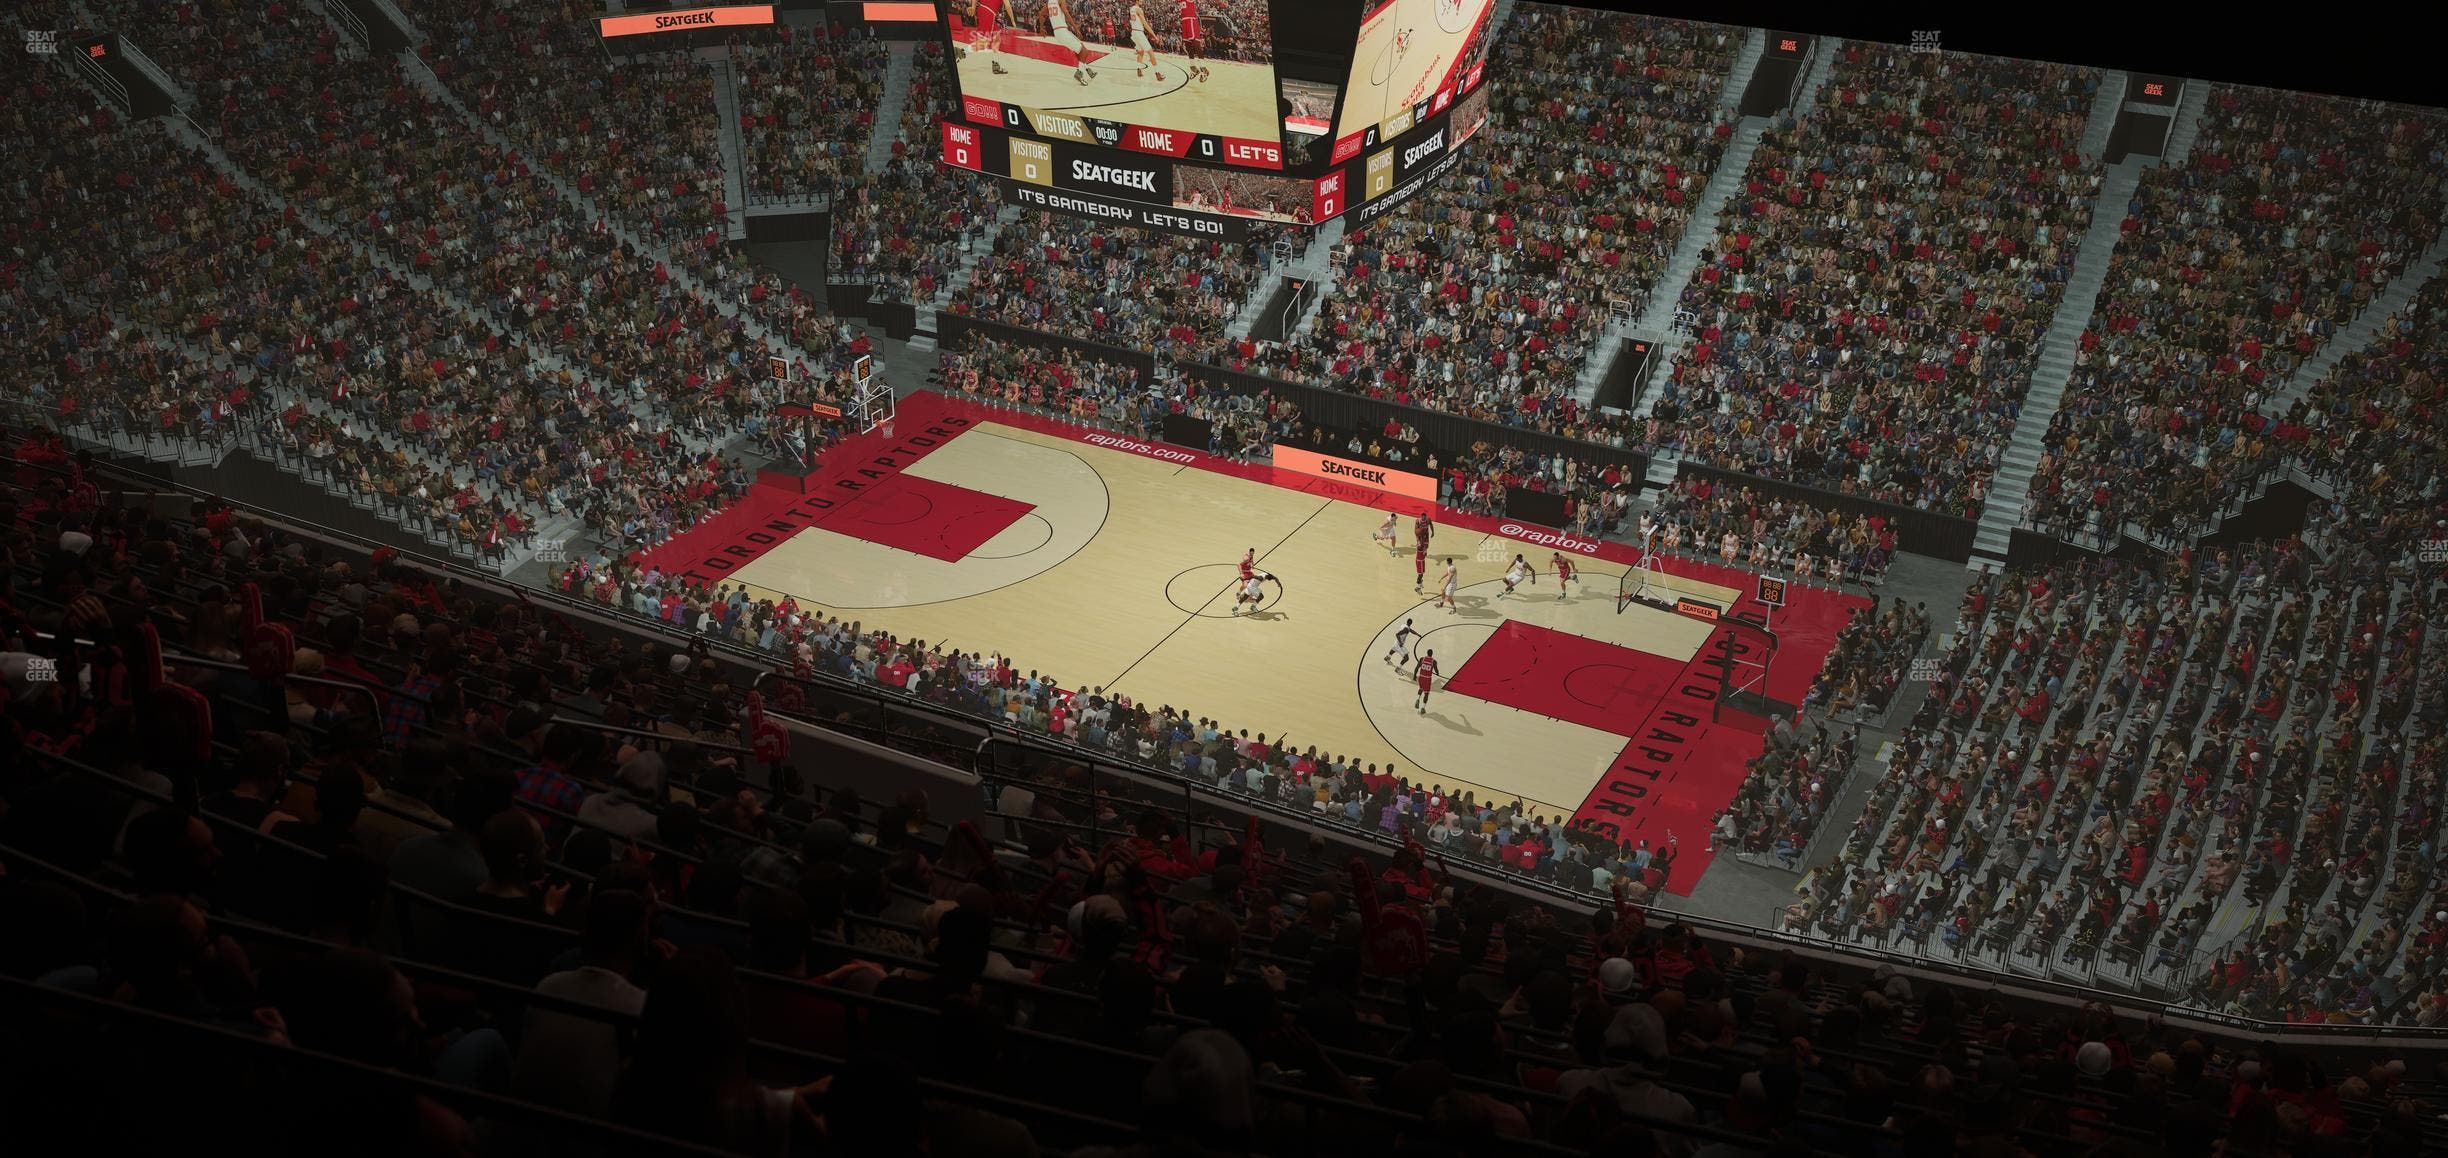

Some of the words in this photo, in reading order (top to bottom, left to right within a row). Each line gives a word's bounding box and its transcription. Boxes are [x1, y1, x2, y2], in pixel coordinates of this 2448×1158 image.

[655, 11, 715, 29] SEATGEEK
[1007, 108, 1019, 125] 0
[1035, 113, 1083, 138] VISITORS
[950, 127, 972, 145] HOME
[1096, 126, 1118, 141] 00:00
[1138, 130, 1174, 152] HOME
[1366, 129, 1375, 147] 0
[956, 149, 968, 164] 0
[1012, 141, 1049, 161] VISITORS
[1201, 139, 1214, 156] 0
[1229, 144, 1279, 163] LET'S
[1404, 128, 1444, 169] SEATGEEK
[1025, 163, 1037, 179] 0
[1072, 159, 1156, 193] SEATGEEK
[1320, 175, 1339, 196] HOME
[1376, 175, 1383, 191] 0
[1018, 188, 1046, 203] IT'S
[1048, 195, 1133, 220] GAMEDAY
[1142, 211, 1190, 229] LET'S
[1194, 220, 1224, 234] GO!
[1324, 199, 1334, 215] 0
[1360, 204, 1378, 221] IT'S
[1083, 431, 1196, 463] raptors.com
[1321, 459, 1386, 486] SEATGEEK
[683, 497, 835, 582] TORONTO
[836, 416, 970, 491] RAPTORS
[1500, 523, 1598, 553] @raptors
[1764, 588, 1778, 601] 88
[1682, 604, 1713, 617] SEATGEEK
[1421, 663, 1431, 671] 00
[1579, 710, 1700, 841] RAPTORS
